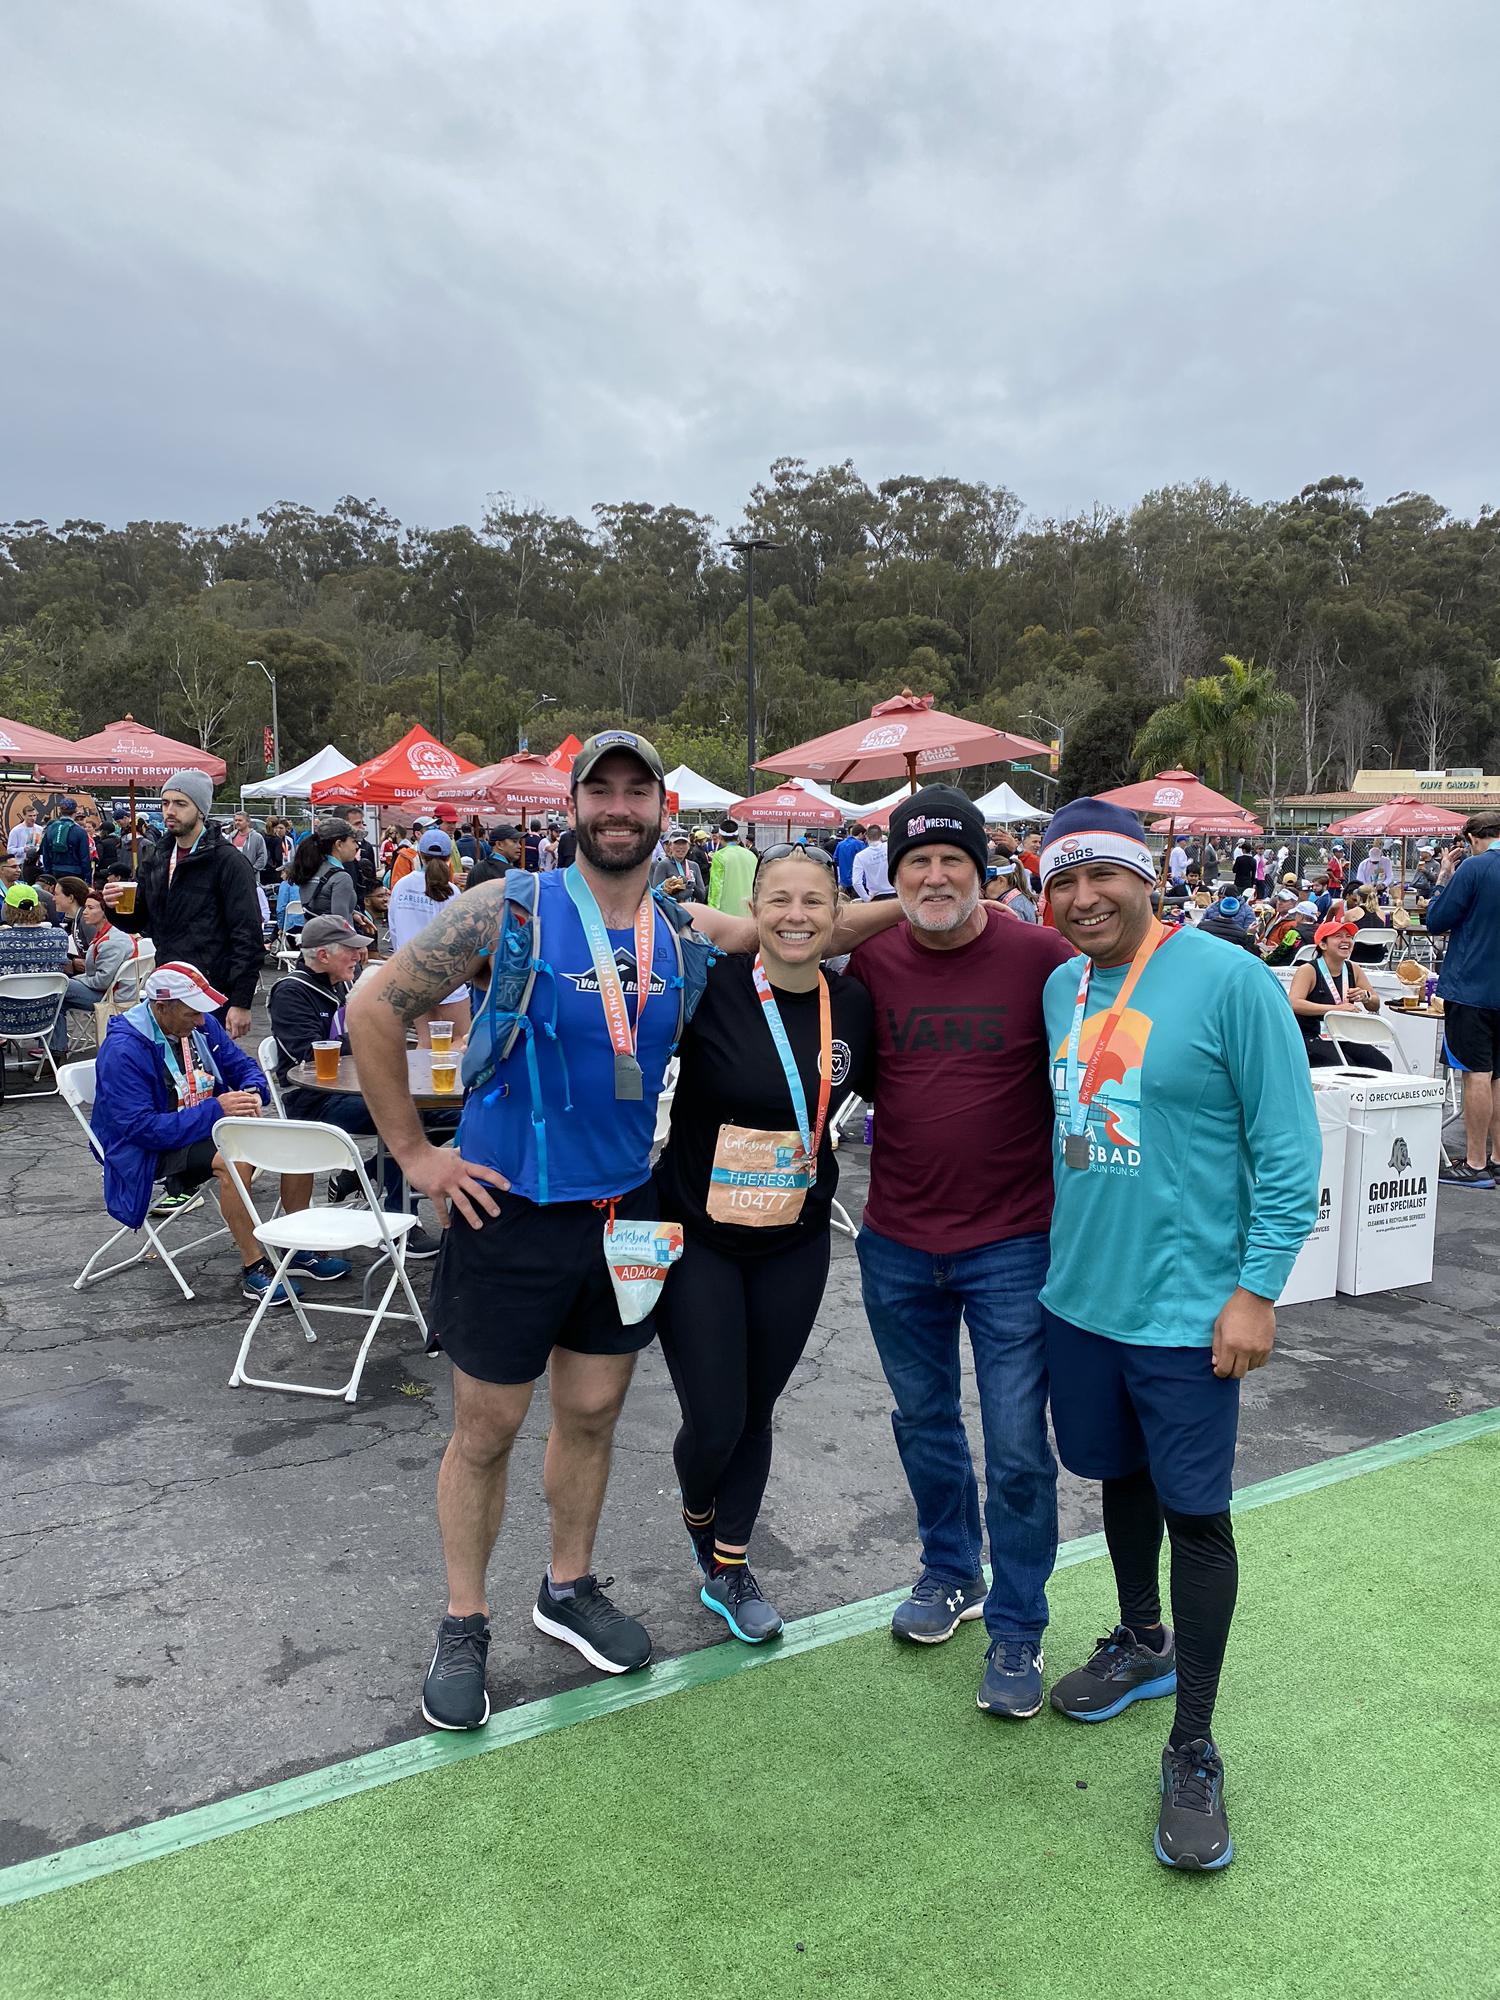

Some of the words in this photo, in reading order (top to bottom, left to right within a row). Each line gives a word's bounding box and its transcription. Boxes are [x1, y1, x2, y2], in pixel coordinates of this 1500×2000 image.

[66, 765, 108, 774] BALLAST
[111, 766, 139, 775] POINT
[410, 763, 461, 773] BALLAST
[423, 770, 457, 778] POINT
[1420, 781, 1442, 790] OLIVE
[1447, 781, 1480, 790] GARDEN
[507, 794, 537, 803] BALLAST
[540, 796, 562, 805] POINT
[925, 818, 963, 831] WRESTLING
[1053, 848, 1094, 867] BEARS
[591, 924, 611, 976] FINISHER
[640, 967, 652, 994] HALF
[601, 978, 628, 1048] MARATHON
[886, 1006, 1008, 1053] VANS
[1085, 1040, 1106, 1089] RUN/WALK
[1082, 1089, 1091, 1102] 5K
[1376, 1090, 1420, 1102] RECYCLABLES
[1422, 1088, 1438, 1098] ONLY
[728, 1171, 796, 1187] THERESA
[1110, 1166, 1127, 1176] RUN
[1129, 1168, 1140, 1177] 5K
[1369, 1177, 1427, 1201] GORILLA
[729, 1189, 791, 1211] 10477
[1368, 1202, 1389, 1215] EVENT
[1390, 1197, 1426, 1212] SPECIALIST
[621, 1267, 658, 1280] ADAM
